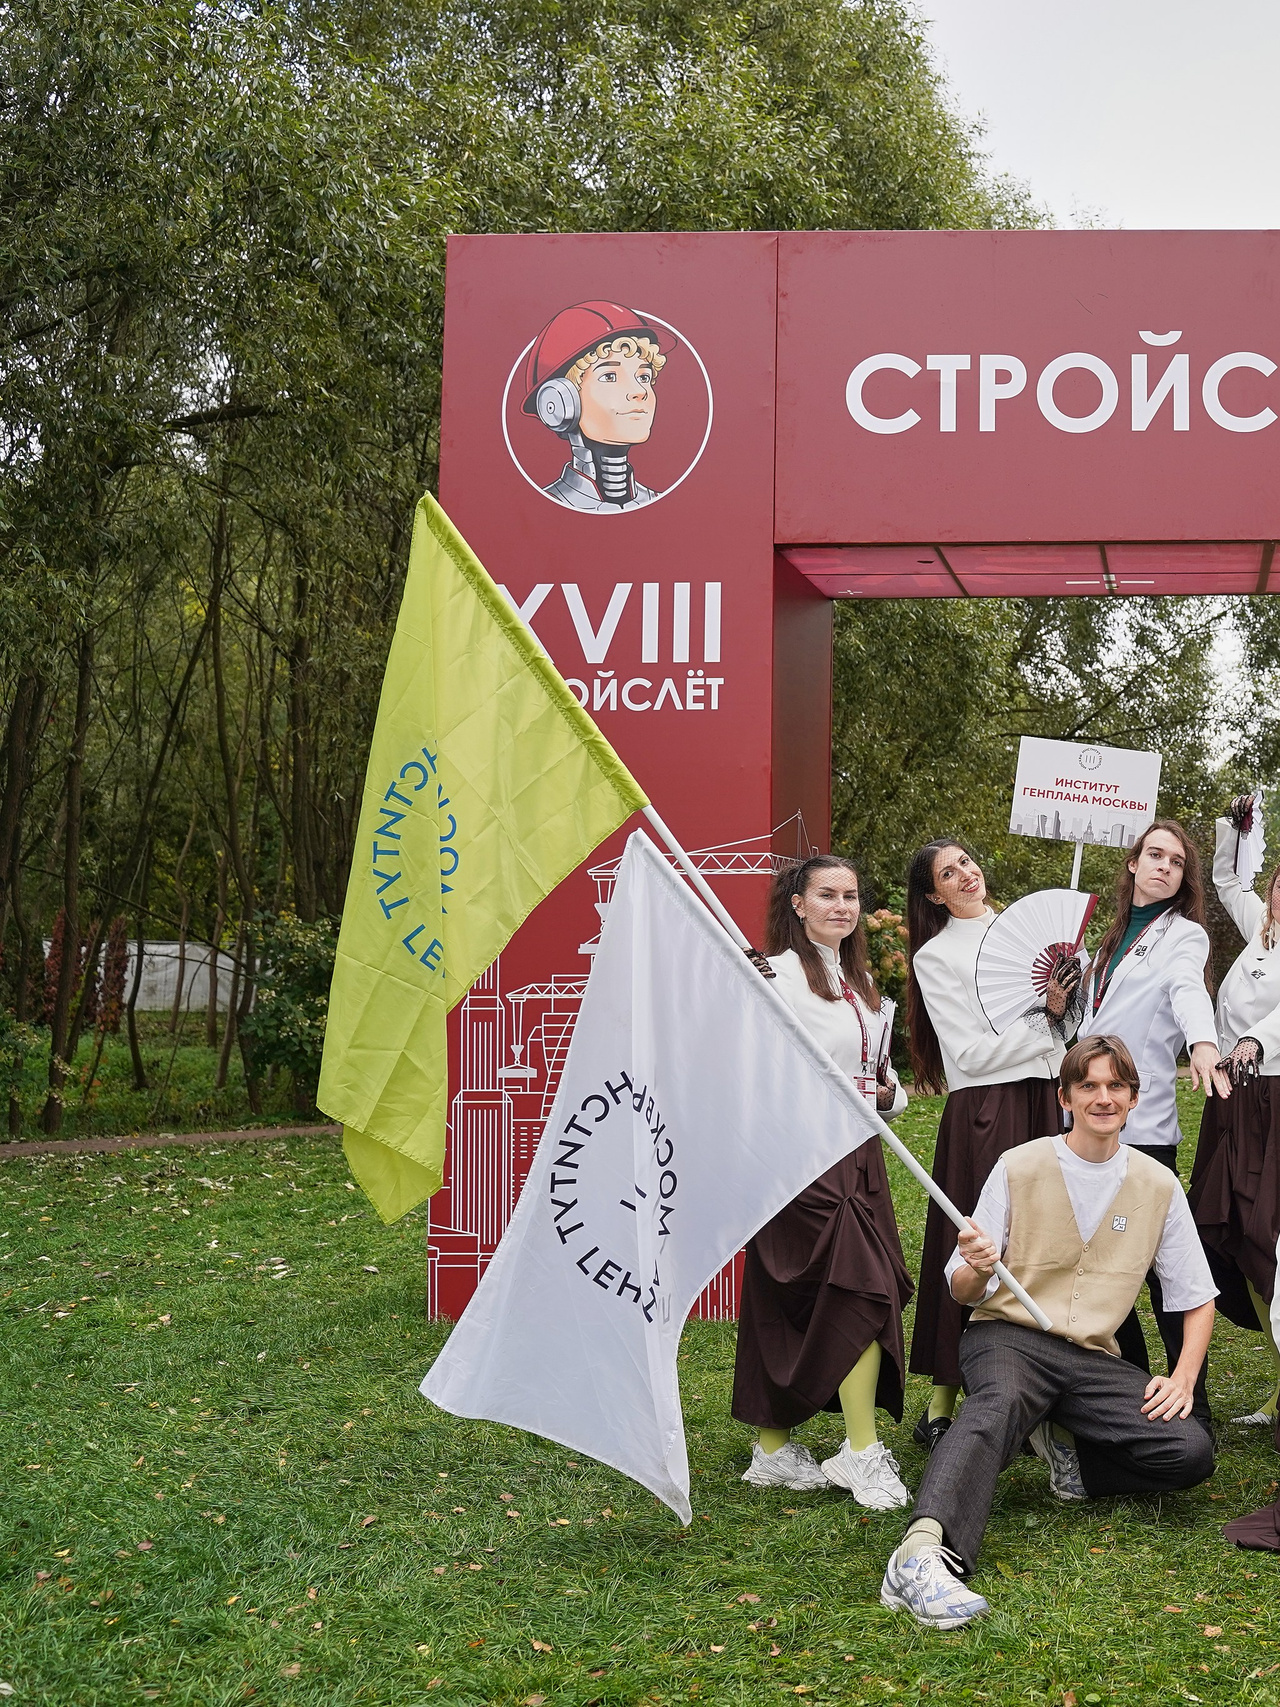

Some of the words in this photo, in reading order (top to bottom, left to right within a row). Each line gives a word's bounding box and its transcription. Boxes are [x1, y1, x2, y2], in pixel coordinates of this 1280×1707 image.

[564, 669, 724, 712] ОЙСЛЁТ
[1055, 777, 1120, 794] ИНСТИТУТ
[1022, 787, 1090, 804] ГЕНПЛАНА
[1091, 796, 1148, 812] МОСКВЫ
